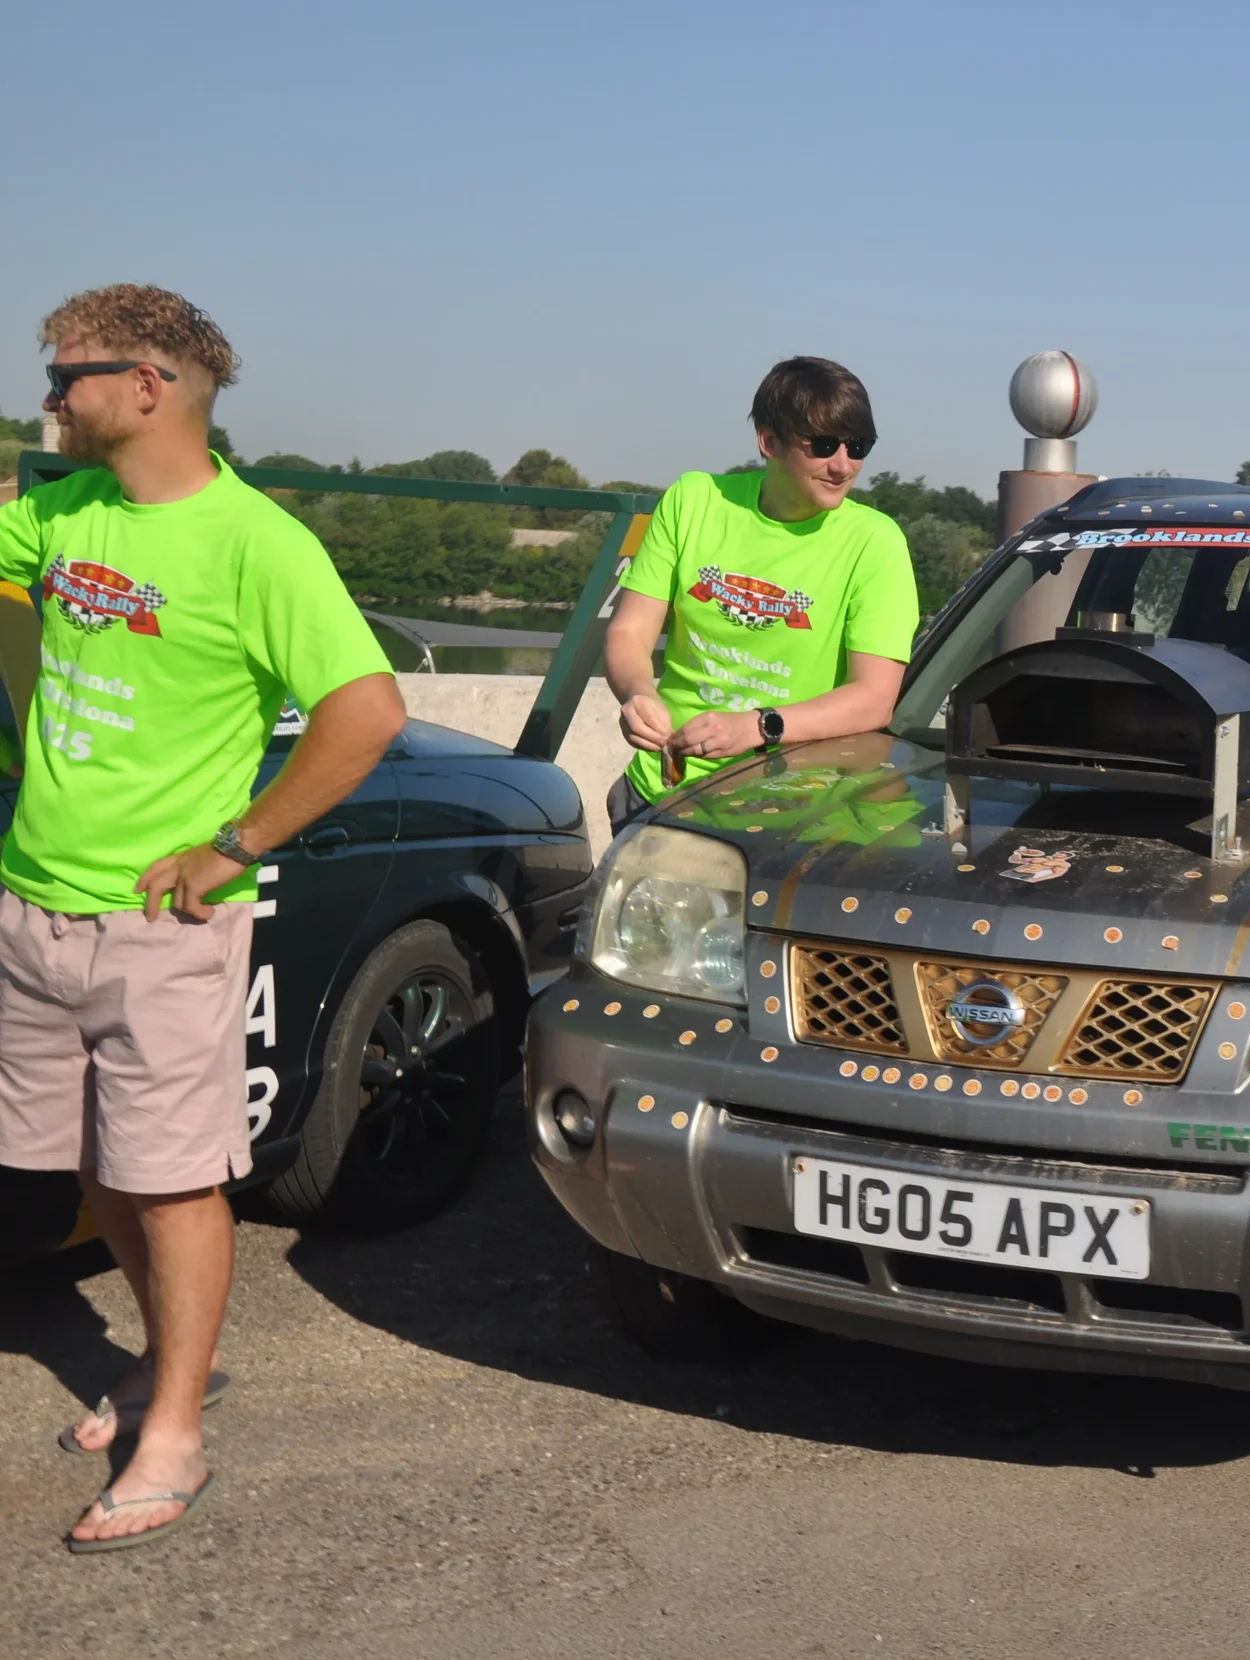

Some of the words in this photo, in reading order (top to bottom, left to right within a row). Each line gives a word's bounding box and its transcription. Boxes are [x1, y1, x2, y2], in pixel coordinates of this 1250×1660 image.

[52, 572, 95, 607] Wacky
[96, 593, 141, 616] Rally
[711, 582, 754, 609] Wacky
[758, 601, 793, 616] Rally
[954, 1006, 1014, 1022] NISSAN
[819, 1170, 975, 1248] HG05
[995, 1197, 1120, 1267] APX
